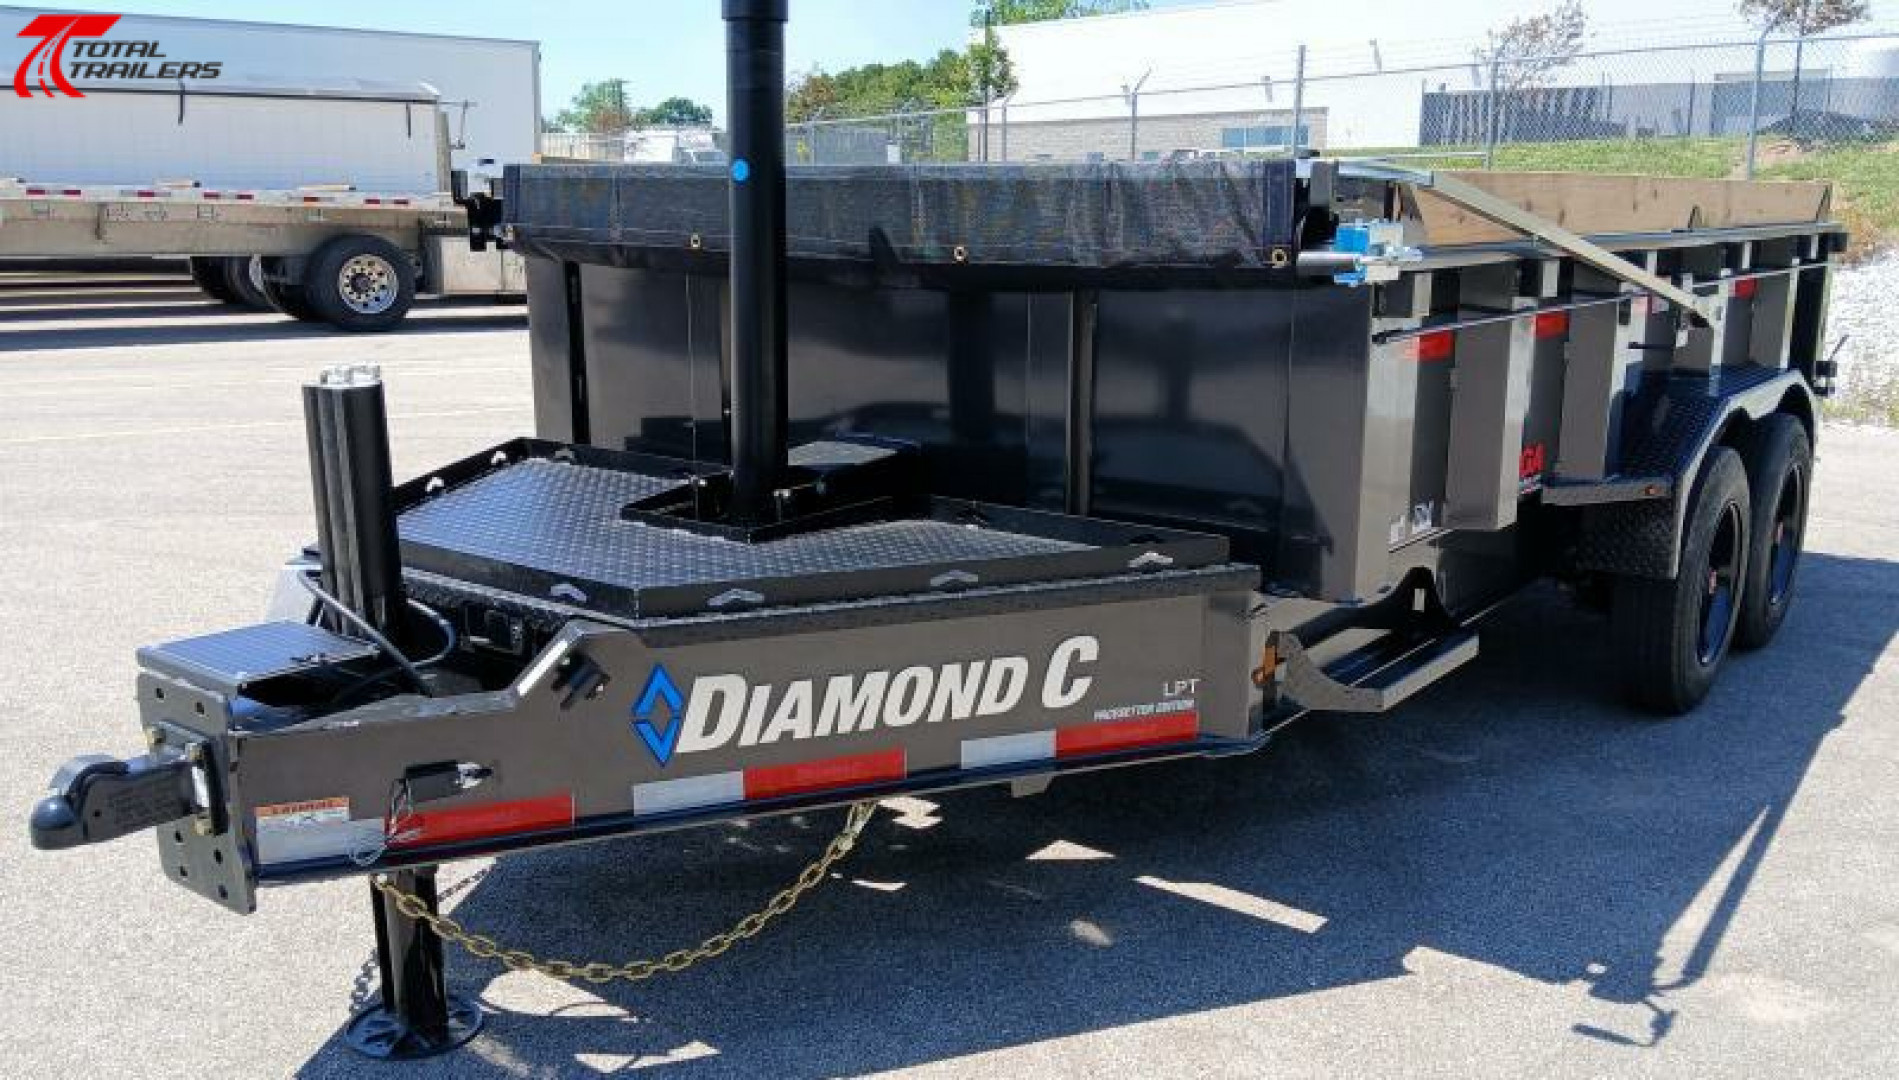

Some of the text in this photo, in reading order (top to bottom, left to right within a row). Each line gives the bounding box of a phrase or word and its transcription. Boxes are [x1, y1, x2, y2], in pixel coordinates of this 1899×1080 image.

[676, 635, 1099, 752] DIAMOND C
[1163, 679, 1200, 696] LPT
